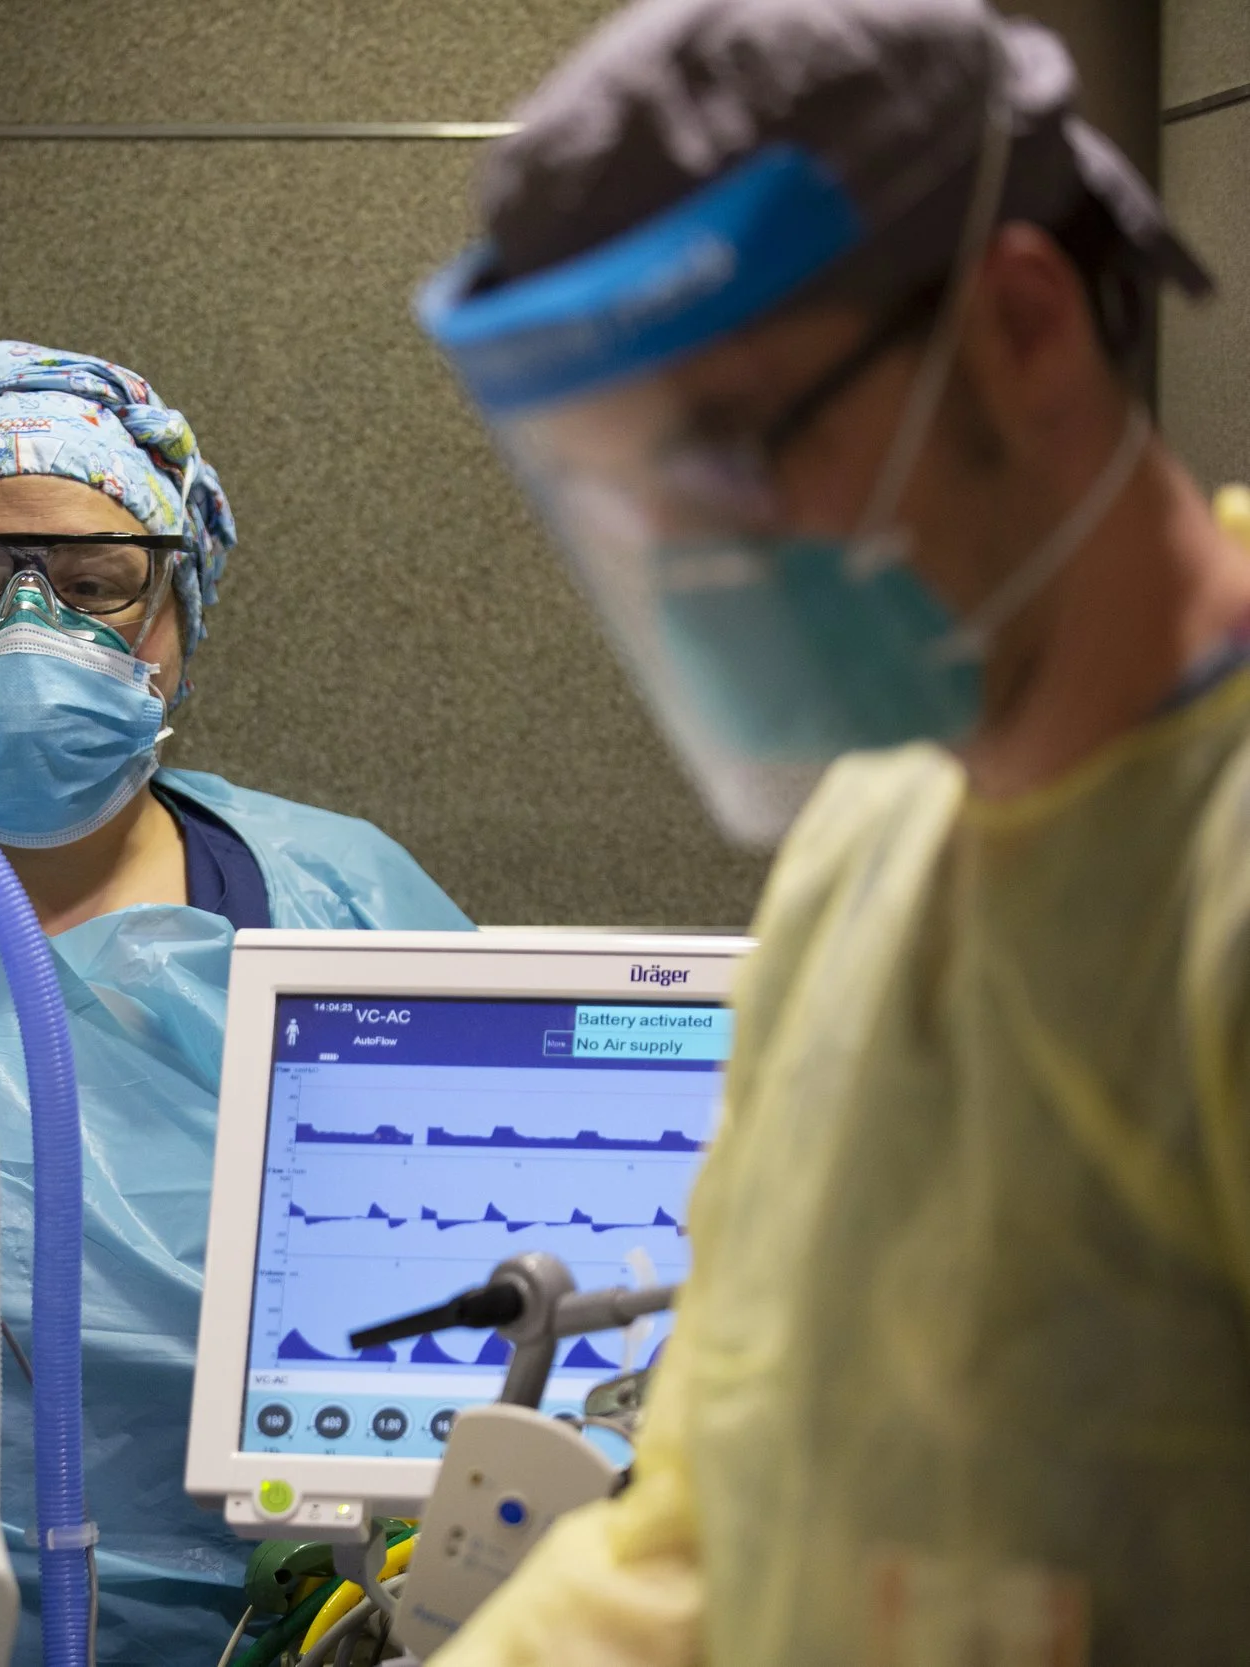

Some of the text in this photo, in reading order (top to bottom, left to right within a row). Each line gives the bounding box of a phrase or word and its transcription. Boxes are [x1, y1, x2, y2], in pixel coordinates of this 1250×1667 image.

[630, 964, 690, 987] Dräger
[314, 1002, 353, 1013] 14:04:23
[355, 1008, 411, 1024] VC-AC
[578, 1012, 713, 1029] Battery activated
[353, 1035, 398, 1046] AutoFlow
[576, 1037, 683, 1055] No Air supply
